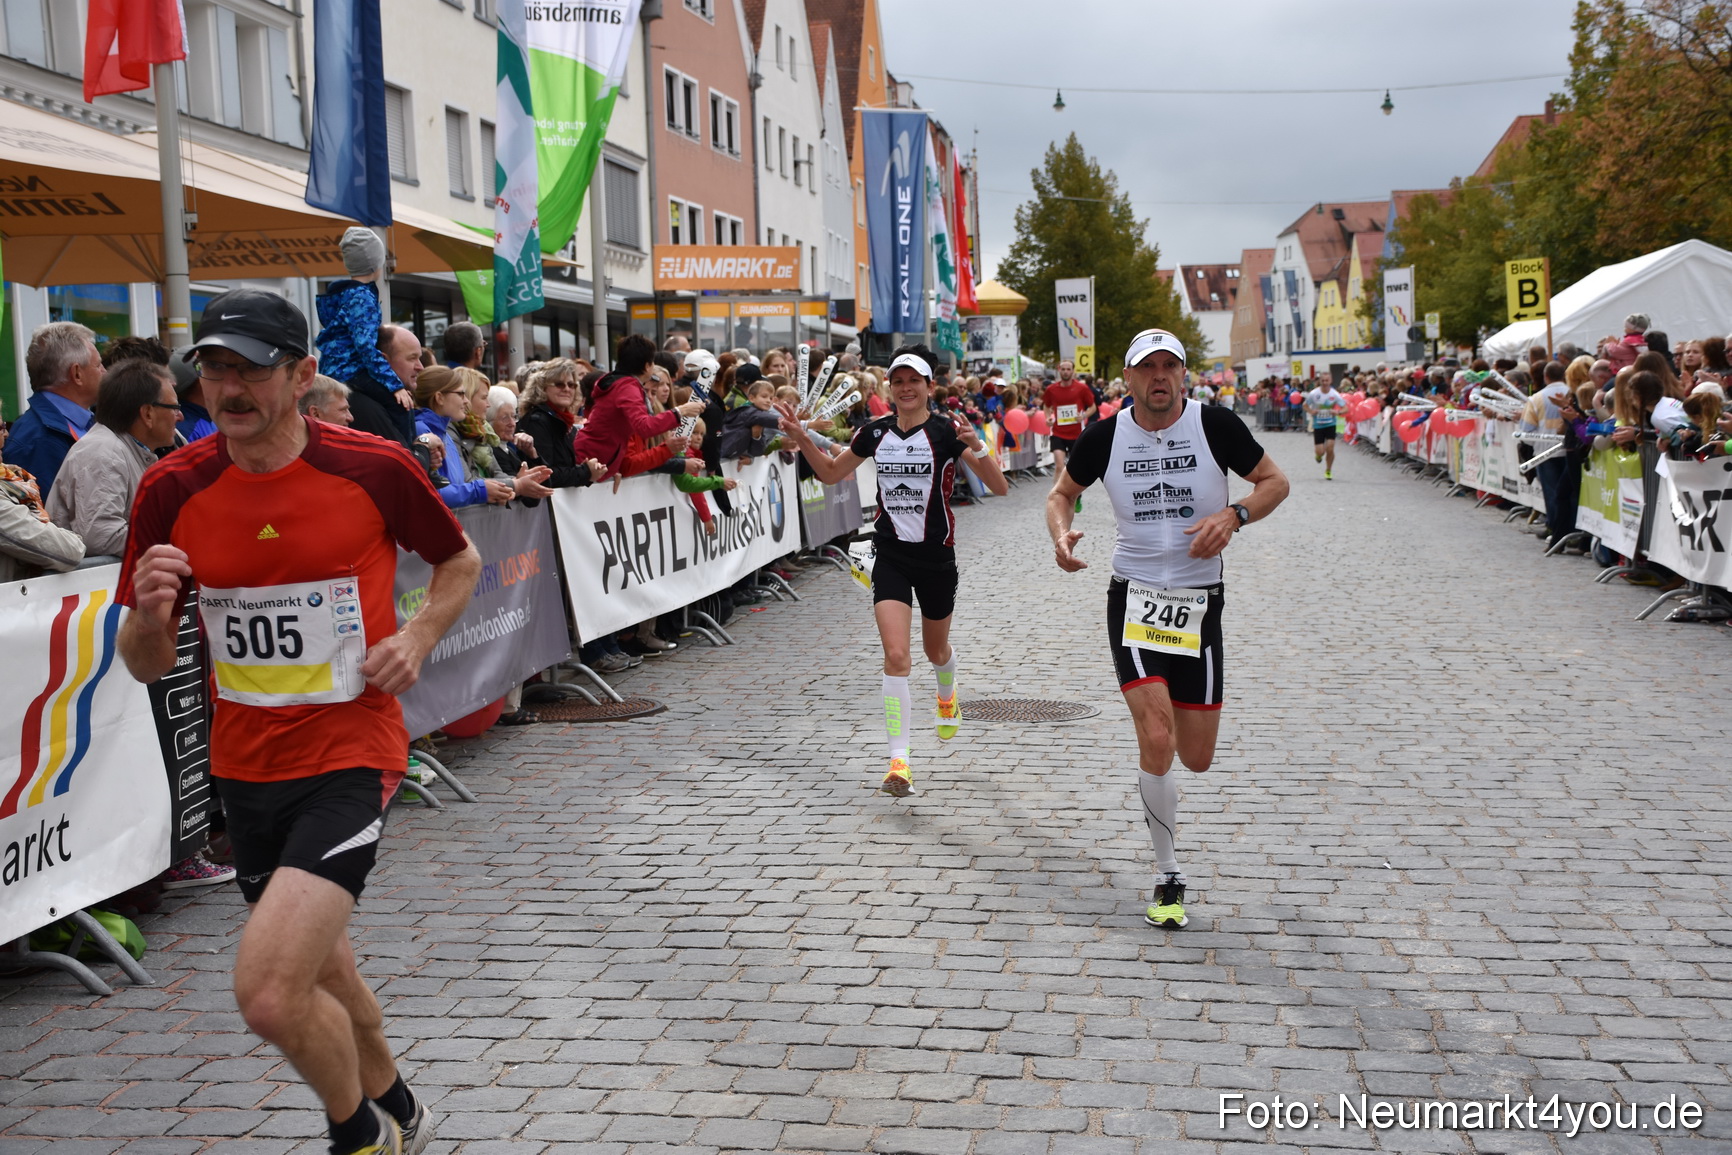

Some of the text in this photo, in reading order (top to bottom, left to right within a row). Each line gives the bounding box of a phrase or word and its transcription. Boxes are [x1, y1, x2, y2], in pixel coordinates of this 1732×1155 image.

[659, 256, 793, 279] RUNMARKT.DE
[1510, 262, 1545, 275] Block
[1517, 278, 1540, 309] B
[1079, 353, 1089, 368] C
[1061, 409, 1074, 418] 151
[1125, 456, 1193, 472] POSITIV
[885, 489, 923, 497] WOLFRUM
[1133, 488, 1192, 500] WOLFRUM
[257, 532, 280, 540] adidas
[594, 505, 687, 595] PARTL
[1129, 587, 1194, 603] PARTL Neumarkt
[200, 596, 302, 611] PARTL Neumarkt
[1141, 600, 1192, 629] 246
[226, 614, 304, 660] 505
[1145, 629, 1183, 645] Werner
